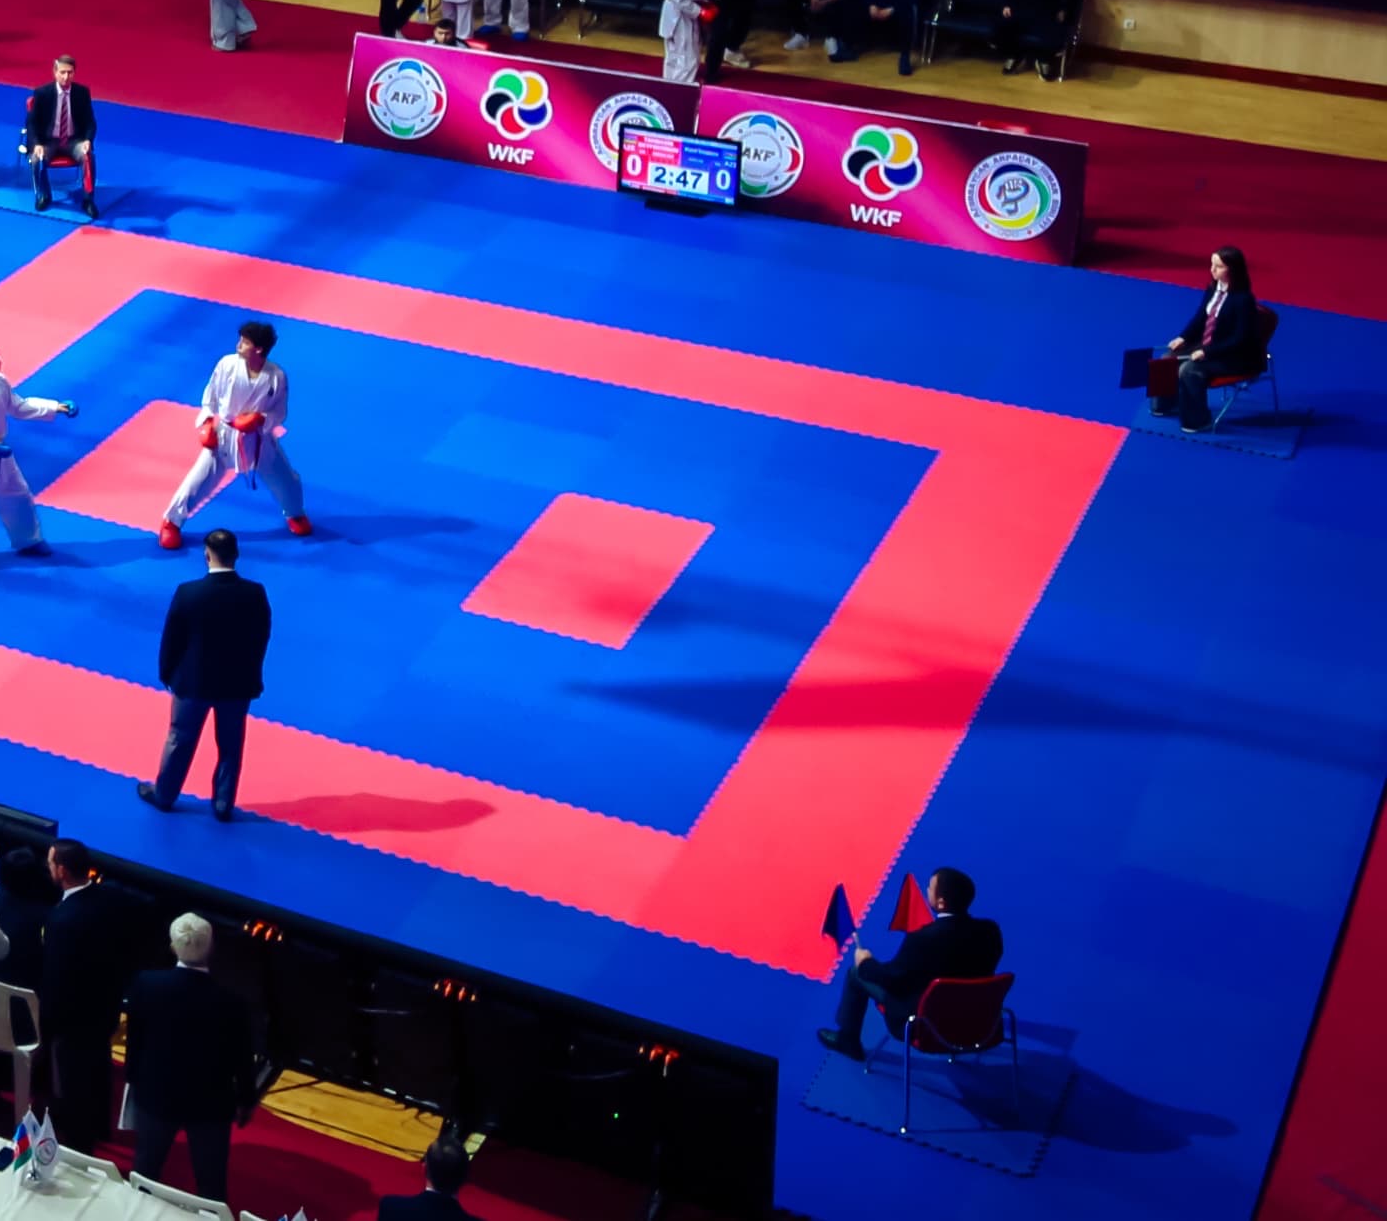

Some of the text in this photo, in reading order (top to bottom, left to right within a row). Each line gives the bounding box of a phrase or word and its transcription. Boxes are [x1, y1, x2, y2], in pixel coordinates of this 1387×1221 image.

[390, 91, 422, 105] AKF
[487, 142, 534, 165] WKF
[626, 153, 642, 176] 0
[741, 147, 775, 162] AKF
[654, 166, 703, 189] 2:47
[716, 169, 731, 190] 0
[850, 203, 902, 227] WKF
